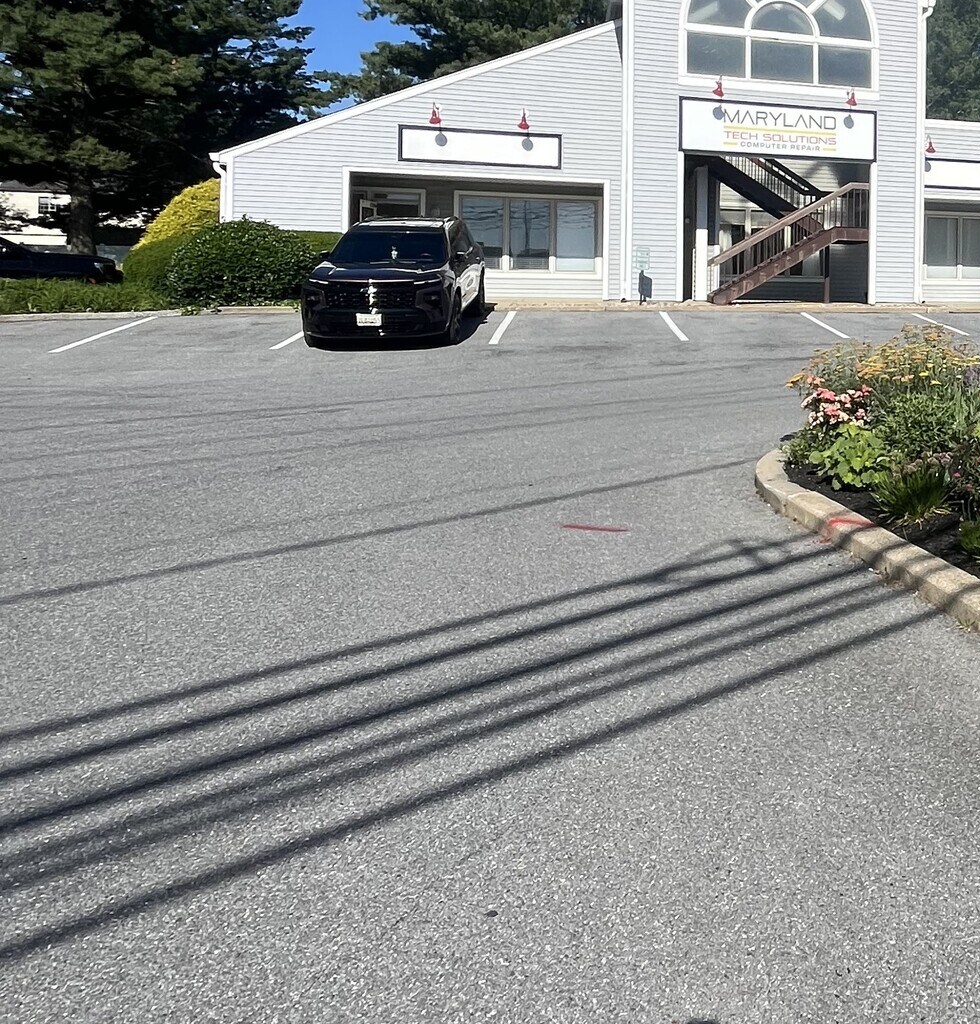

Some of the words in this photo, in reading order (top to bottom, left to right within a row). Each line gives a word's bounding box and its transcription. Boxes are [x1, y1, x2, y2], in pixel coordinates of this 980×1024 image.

[723, 108, 837, 130] MARYLAND
[723, 130, 758, 140] TECH
[762, 133, 837, 146] SOLUTIONS
[740, 141, 788, 150] COMPUTER
